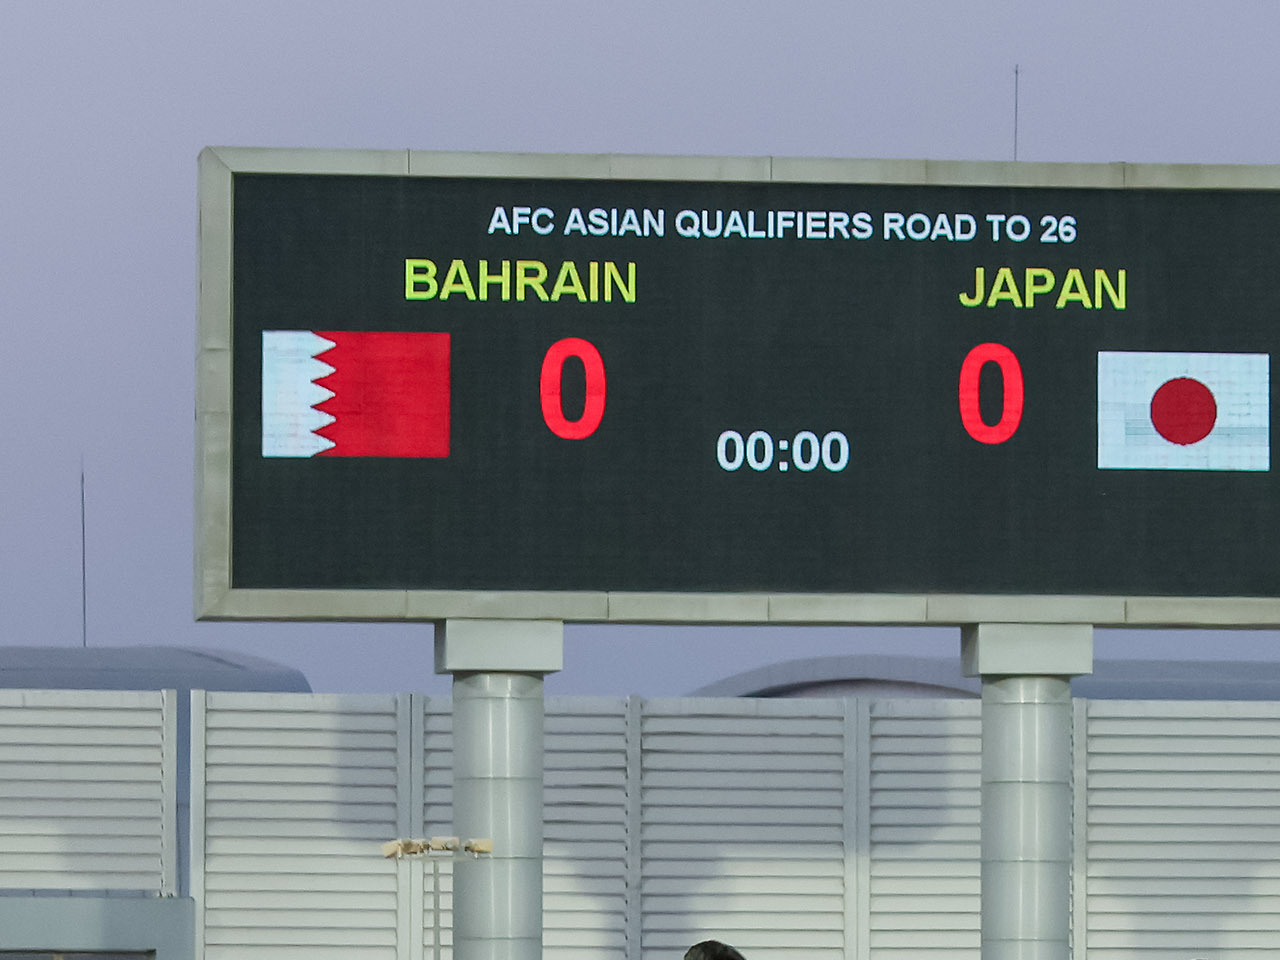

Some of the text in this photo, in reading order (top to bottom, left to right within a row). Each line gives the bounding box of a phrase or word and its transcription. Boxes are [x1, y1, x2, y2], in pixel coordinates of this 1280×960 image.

[488, 206, 1077, 243] AFC ASIAN QUALIFIERS ROAD TO 26
[404, 258, 637, 303] BAHRAIN
[958, 267, 1127, 310] JAPAN
[539, 337, 607, 441] 0
[958, 342, 1025, 445] 0
[716, 430, 850, 472] 00:00
